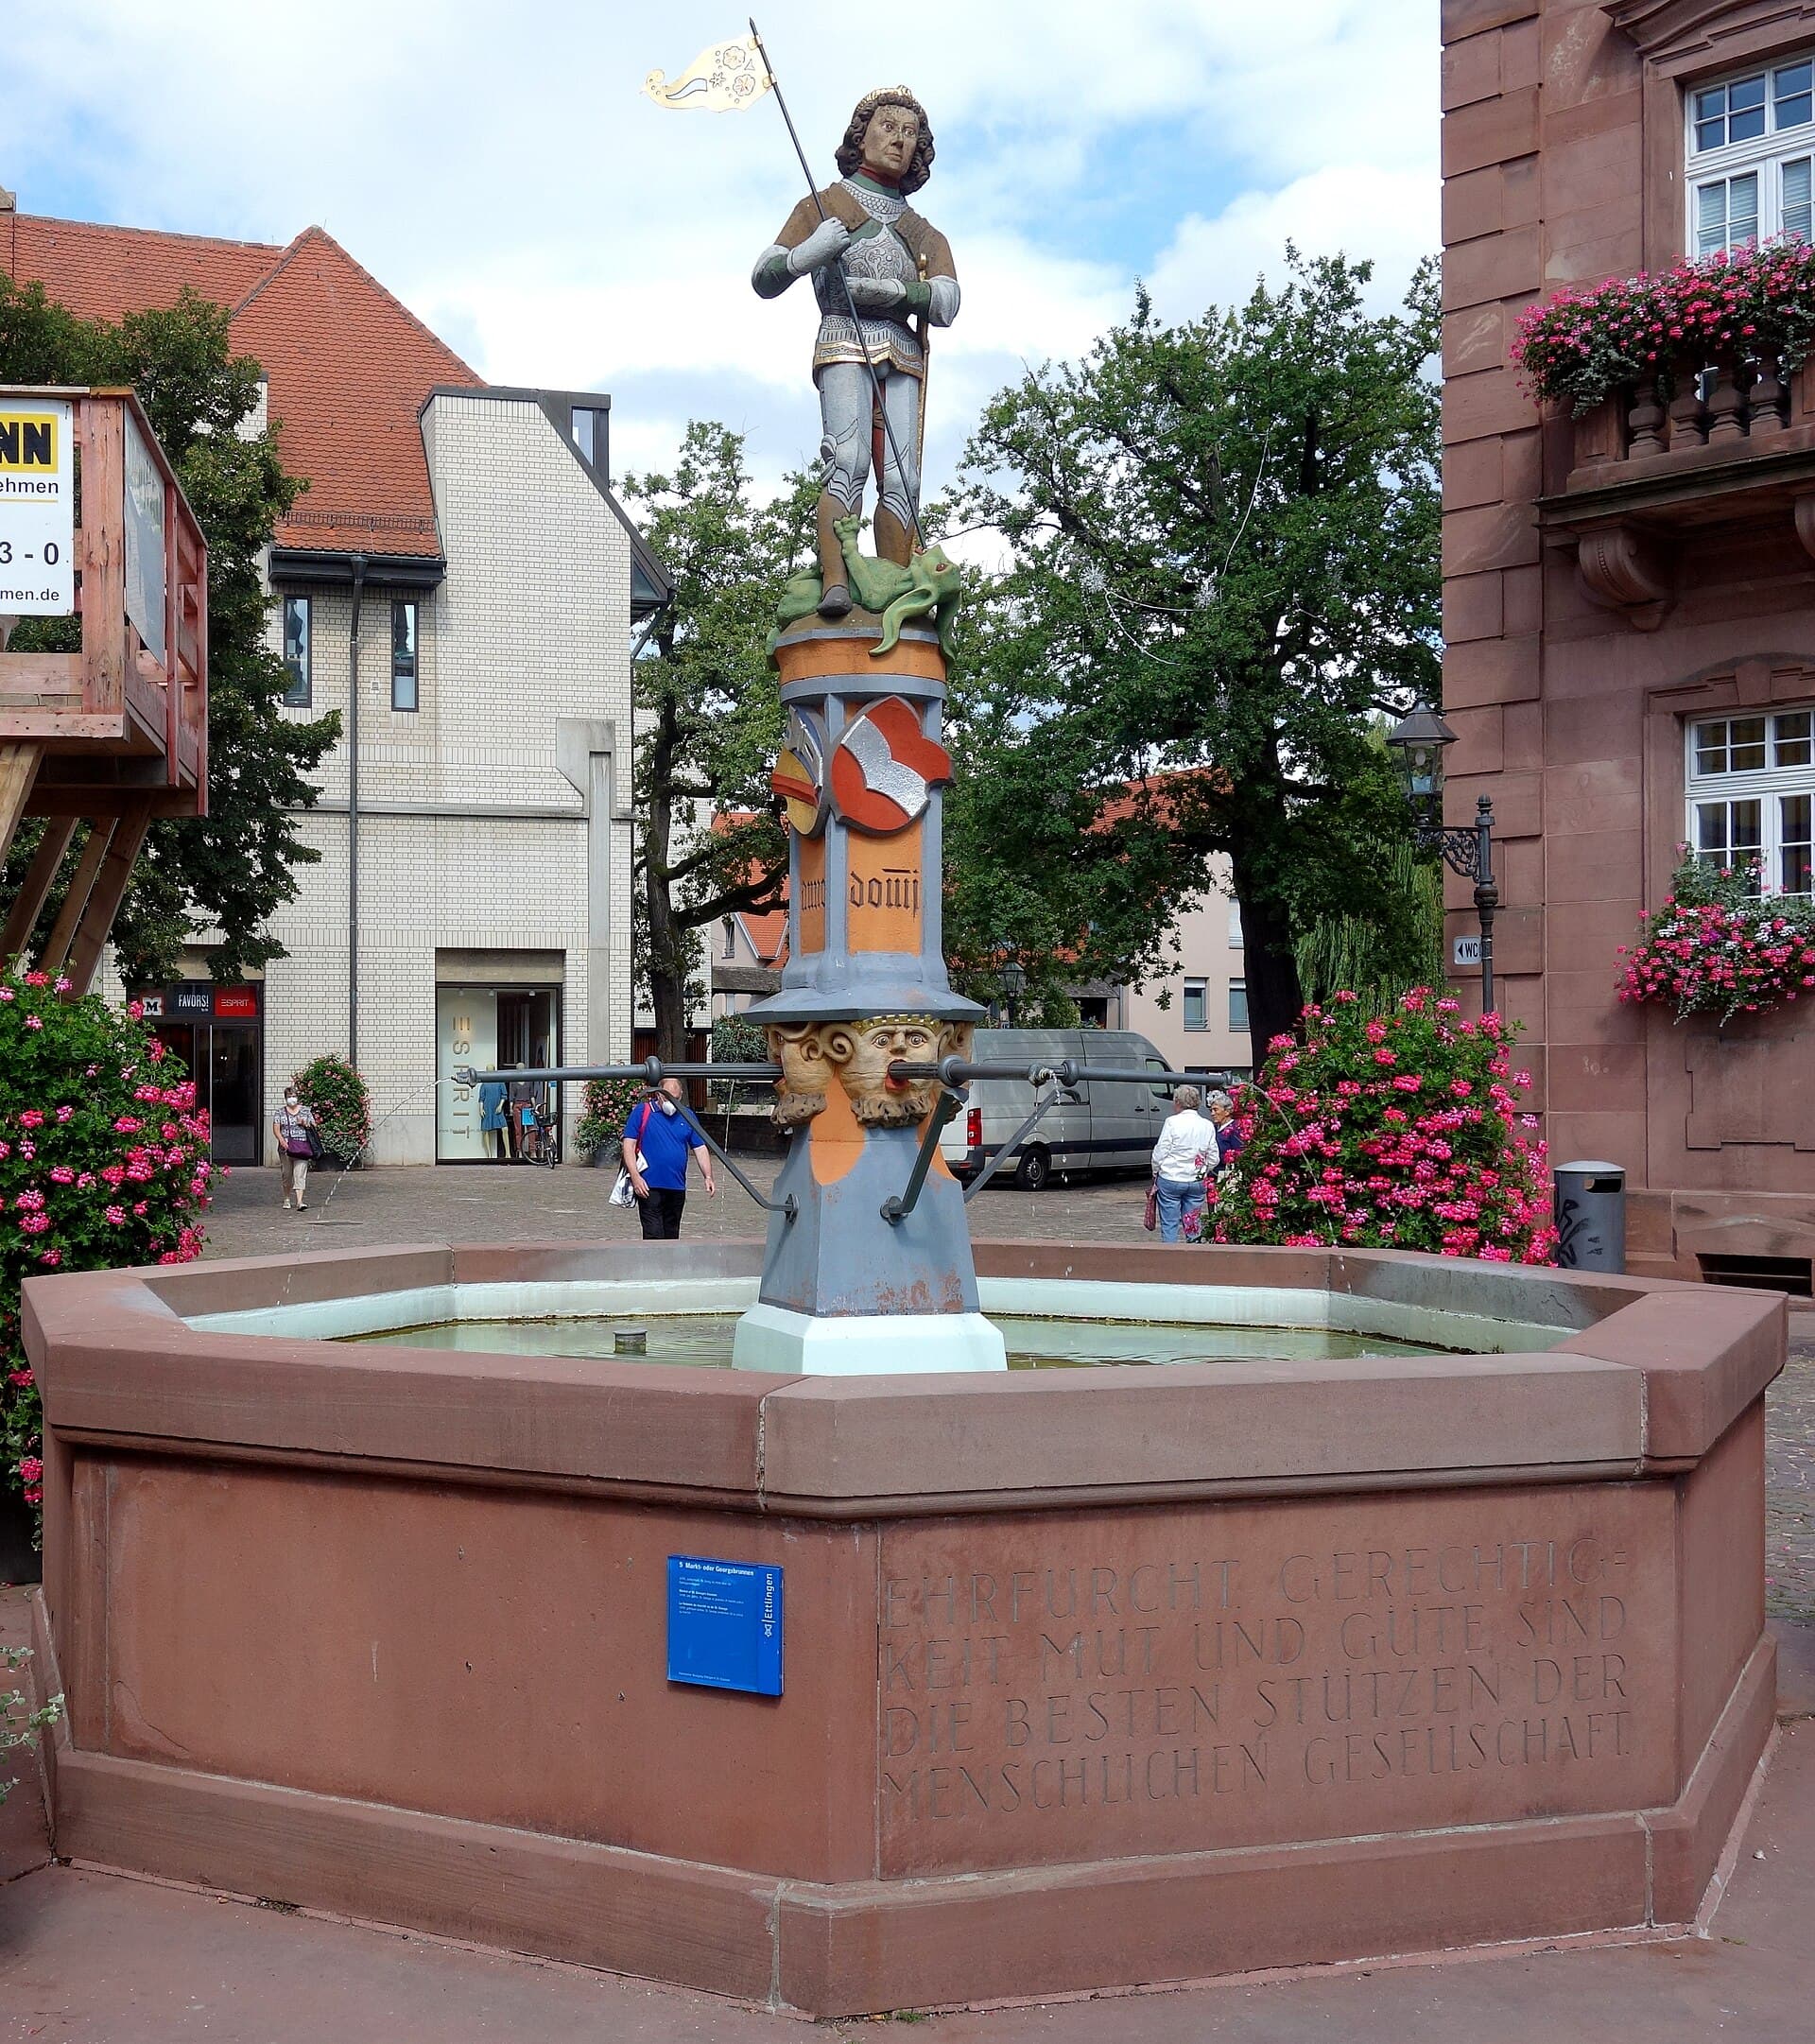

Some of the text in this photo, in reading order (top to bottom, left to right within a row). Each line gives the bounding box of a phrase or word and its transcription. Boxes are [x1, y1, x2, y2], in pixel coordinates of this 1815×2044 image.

[43, 543, 59, 565] 0
[1465, 943, 1478, 958] WC
[145, 999, 160, 1013] M
[764, 1573, 775, 1620] Ettlingen
[1040, 1626, 1160, 1682] MUT
[1194, 1618, 1305, 1672] UND
[1516, 1596, 1626, 1647] SIND
[885, 1702, 975, 1757] DIE
[1006, 1684, 1219, 1747] BESTEN
[1533, 1654, 1627, 1705] DER
